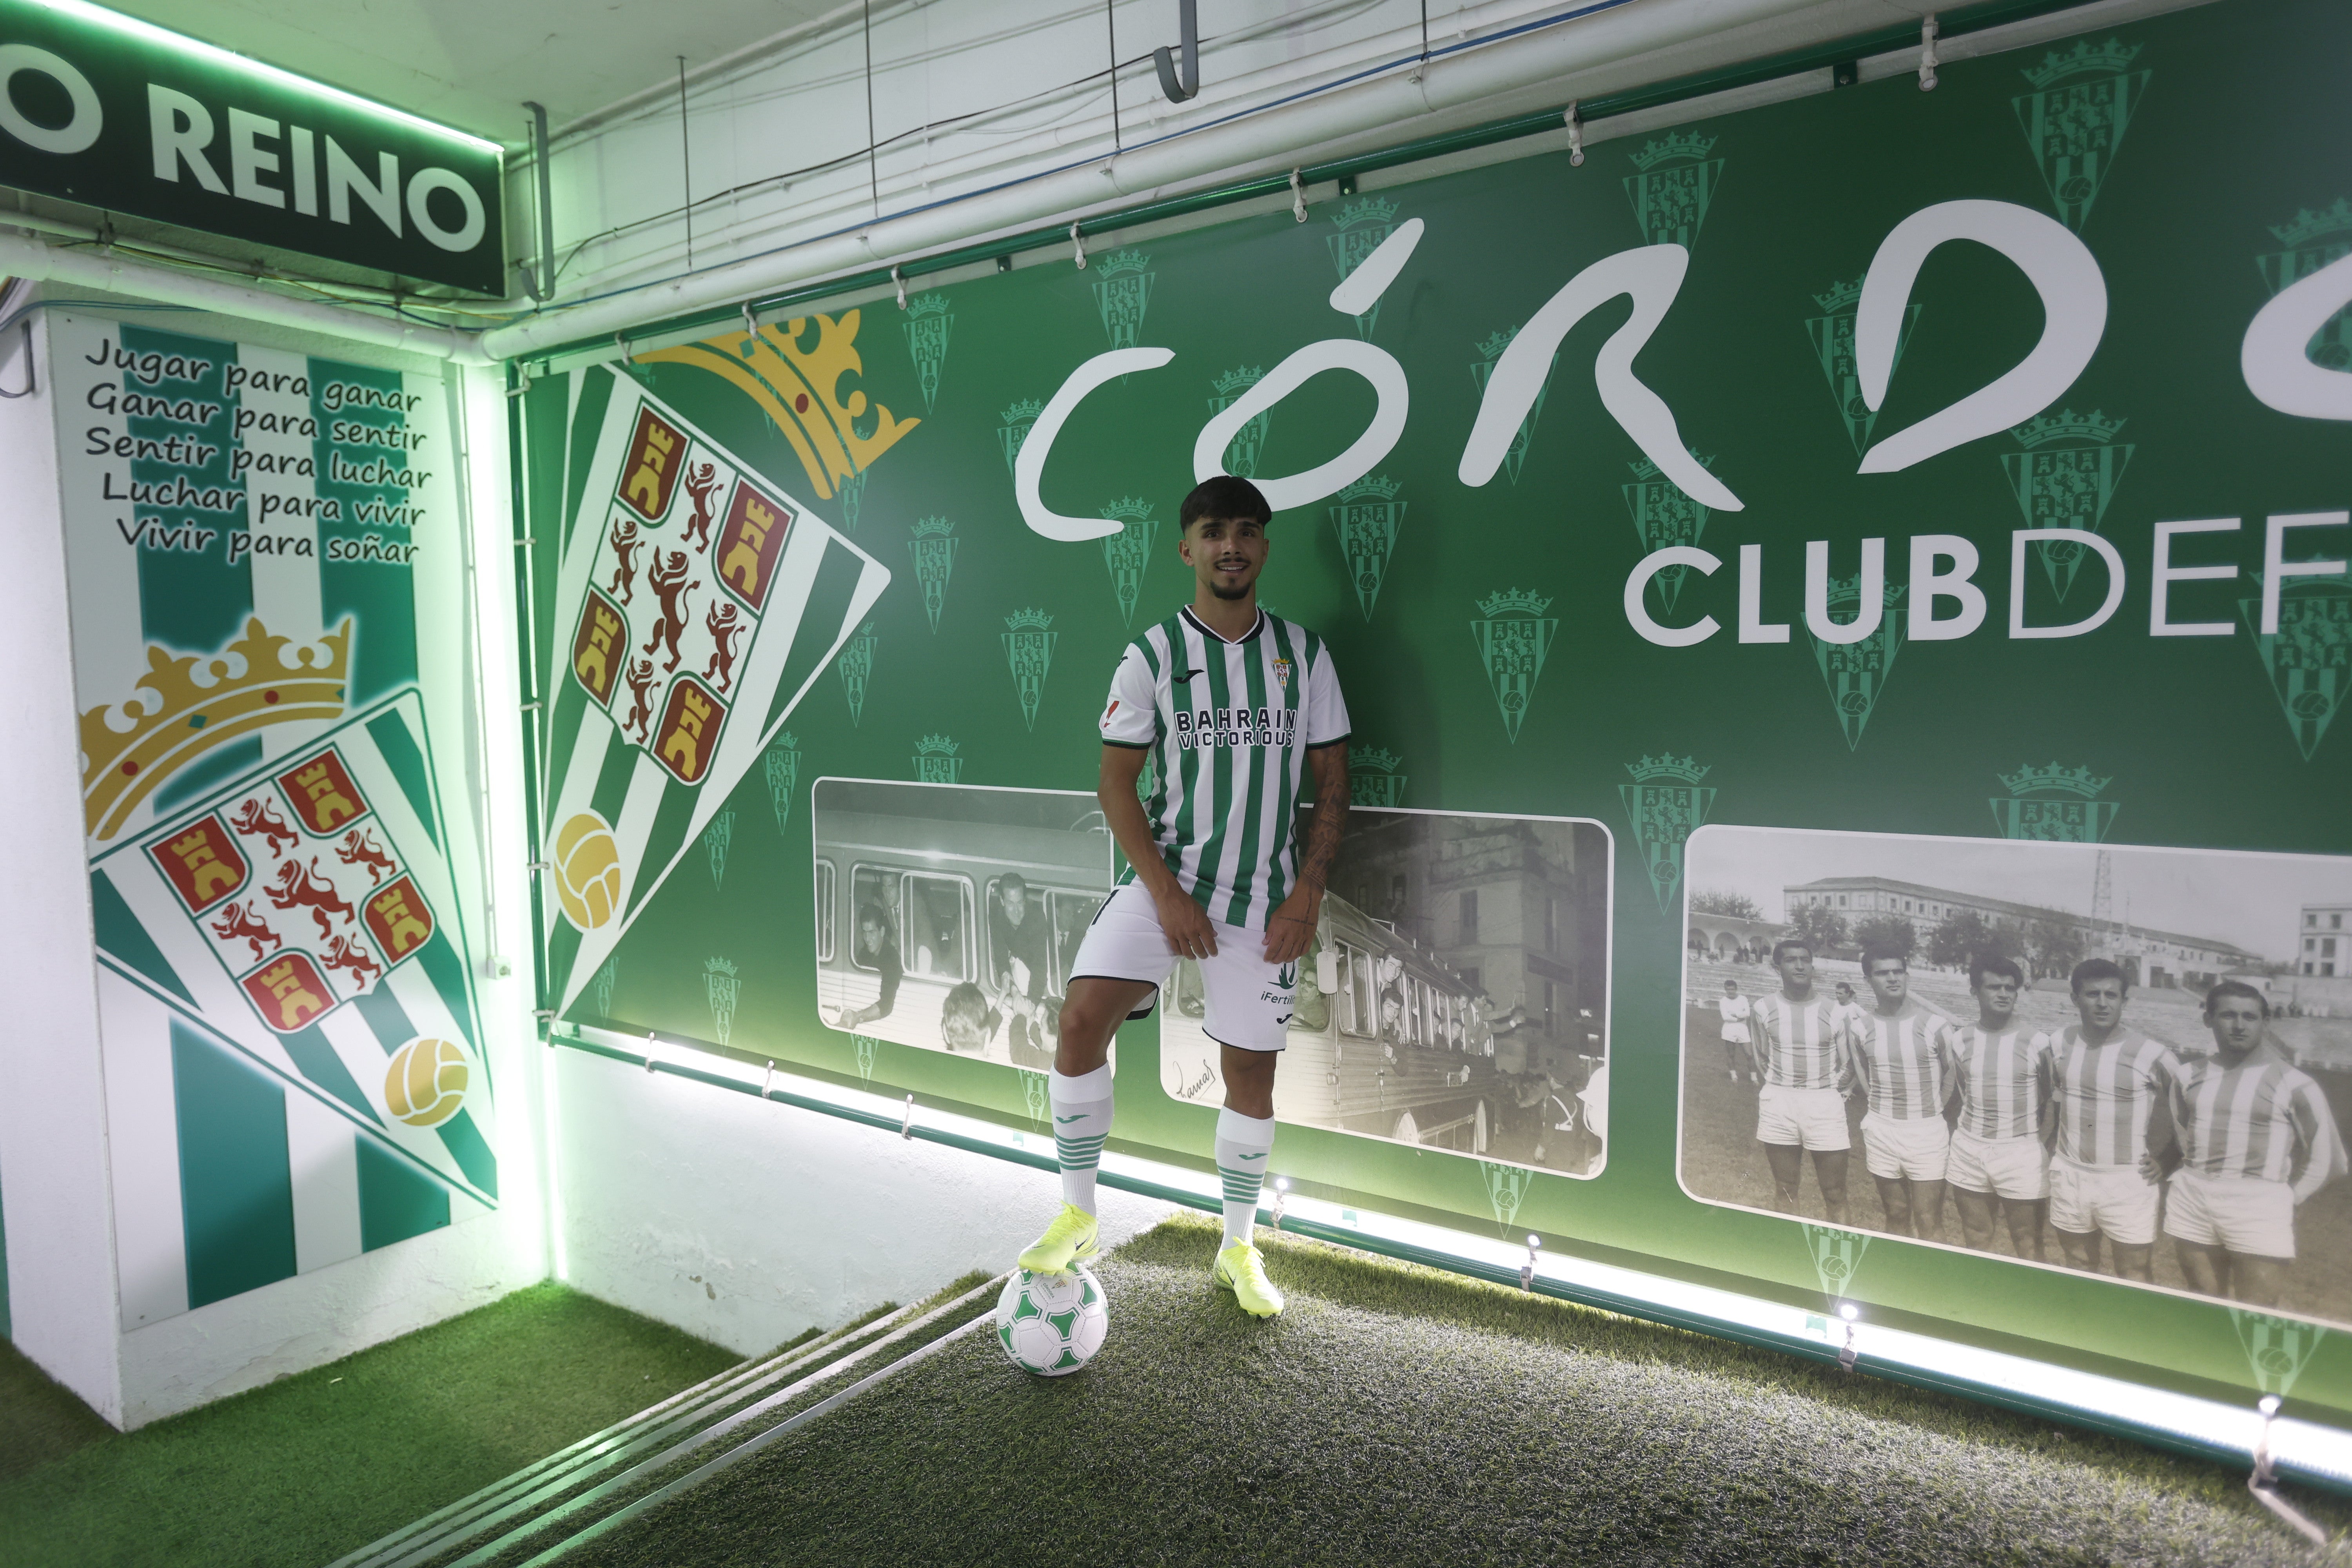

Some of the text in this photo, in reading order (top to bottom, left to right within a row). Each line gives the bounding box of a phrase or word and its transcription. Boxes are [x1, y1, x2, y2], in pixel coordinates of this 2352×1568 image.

[147, 83, 486, 252] REINO
[85, 338, 422, 412] Jugar para ganar
[87, 382, 427, 450] Ganar para sentir
[86, 427, 433, 489] Sentir para luchar
[103, 472, 426, 525] Luchar para vivir
[116, 517, 419, 563] Vivir para soñar
[1176, 708, 1296, 732] BAHRAIN
[1179, 730, 1294, 749] VICTORIOUS
